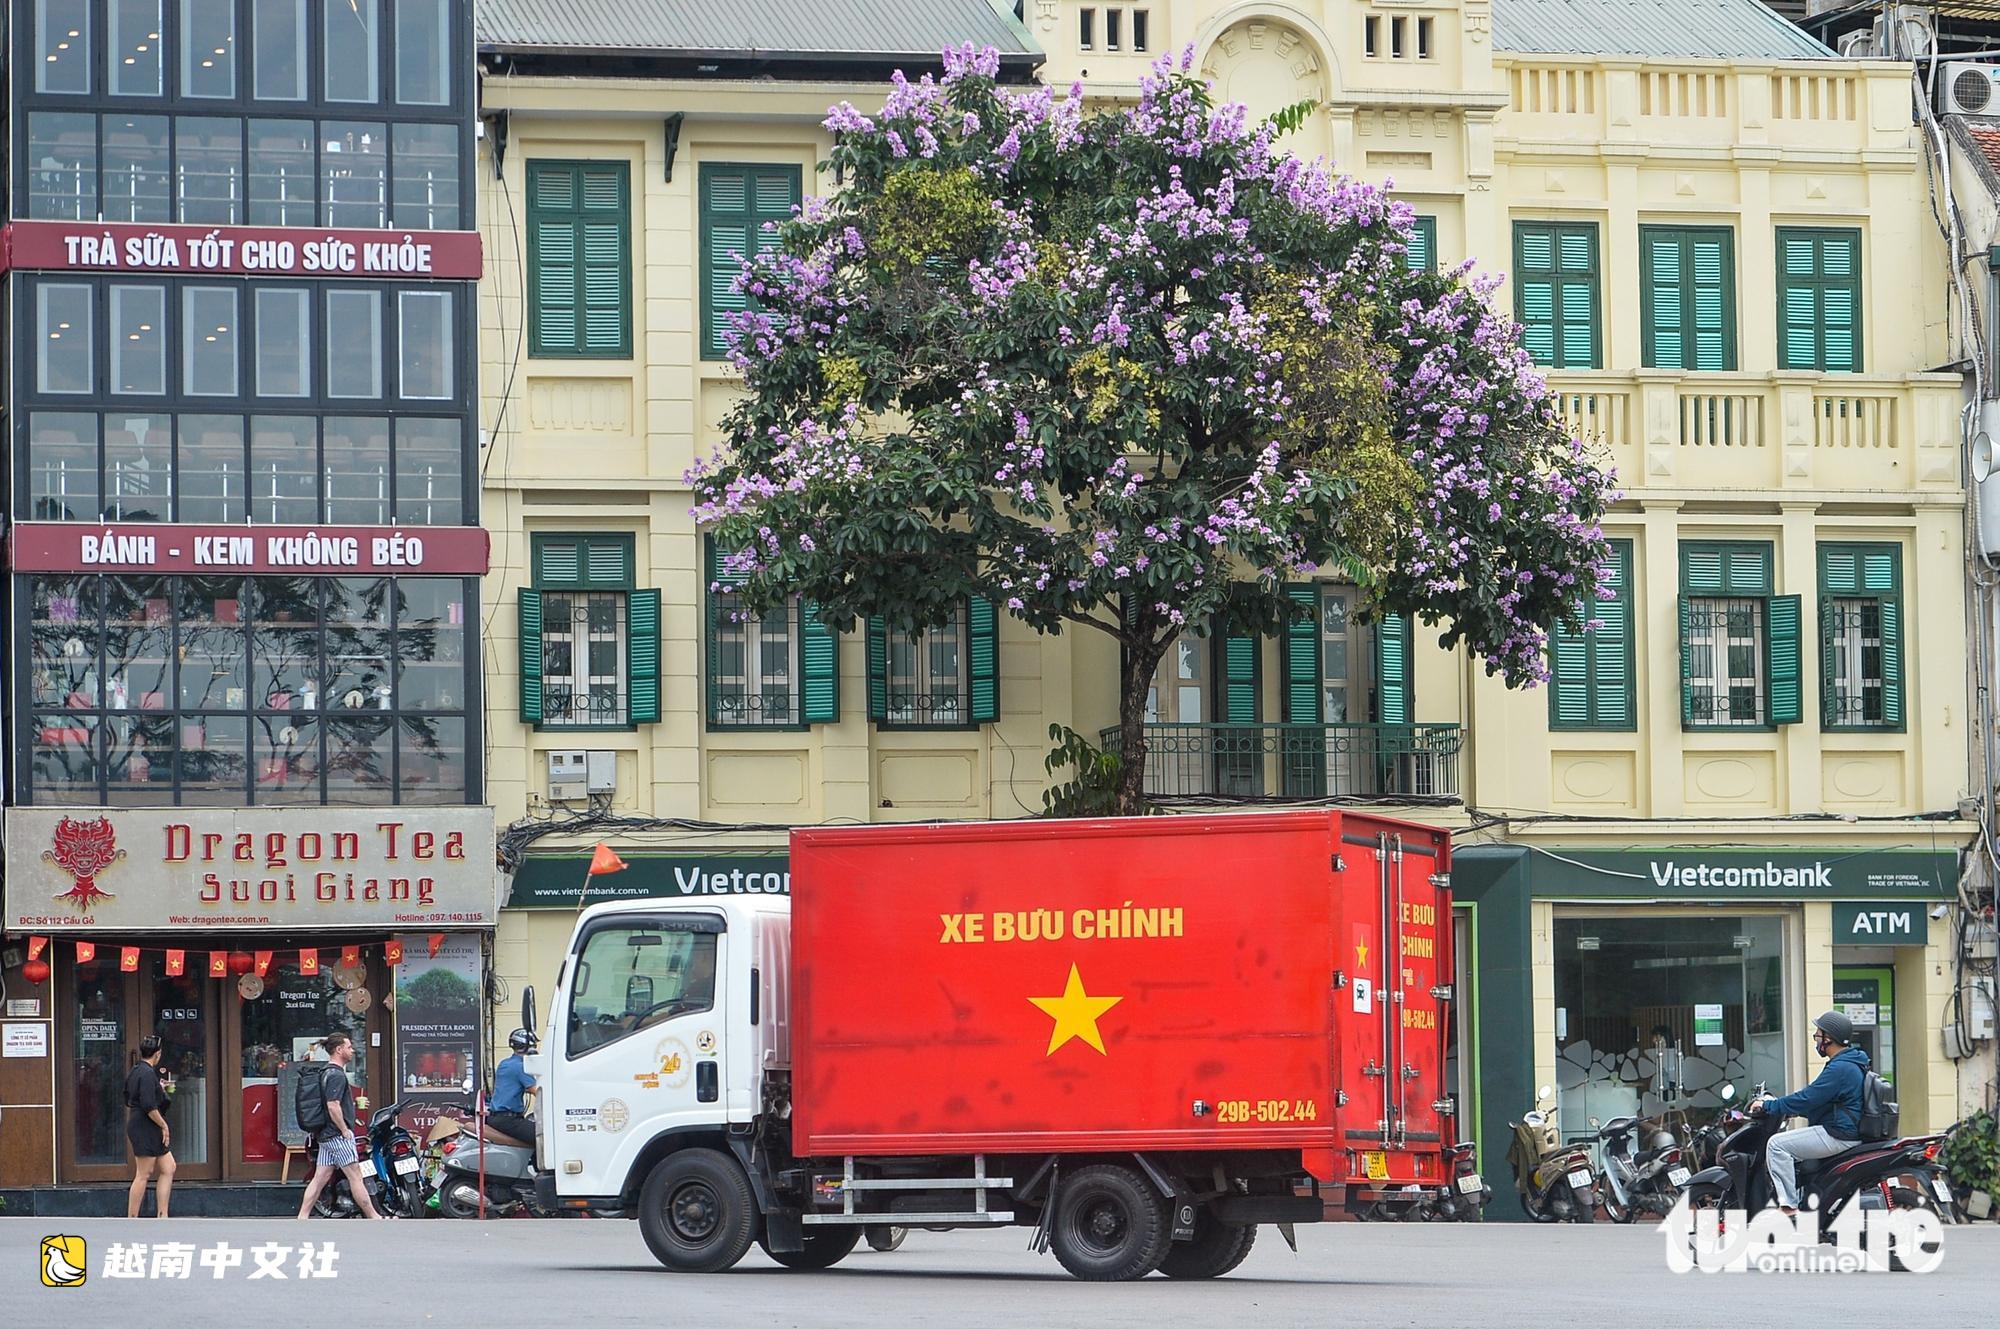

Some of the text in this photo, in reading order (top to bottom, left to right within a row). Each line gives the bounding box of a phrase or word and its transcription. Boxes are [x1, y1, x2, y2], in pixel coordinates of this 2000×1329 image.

[64, 229, 432, 273] TRÀ SỮA TỐT CHO SỨC KHỎE
[81, 529, 155, 564] BÁNH
[194, 536, 253, 566] KEM
[268, 531, 358, 566] KHÔNG
[372, 532, 423, 566] BÉO
[162, 823, 465, 869] Dragon Tea
[673, 866, 790, 894] Vietco
[1650, 861, 1832, 888] Vietcombank
[200, 872, 435, 906] Suoi Giang
[534, 887, 649, 896] www.vietcombank.com.vn
[192, 916, 269, 925] dragontea.com.vn
[939, 901, 1184, 944] XE BƯU CHÍNH
[1412, 903, 1435, 927] BƯU
[1852, 912, 1910, 934] ATM
[413, 1117, 424, 1129] VỊ
[1217, 1099, 1316, 1124] 29B-502.44
